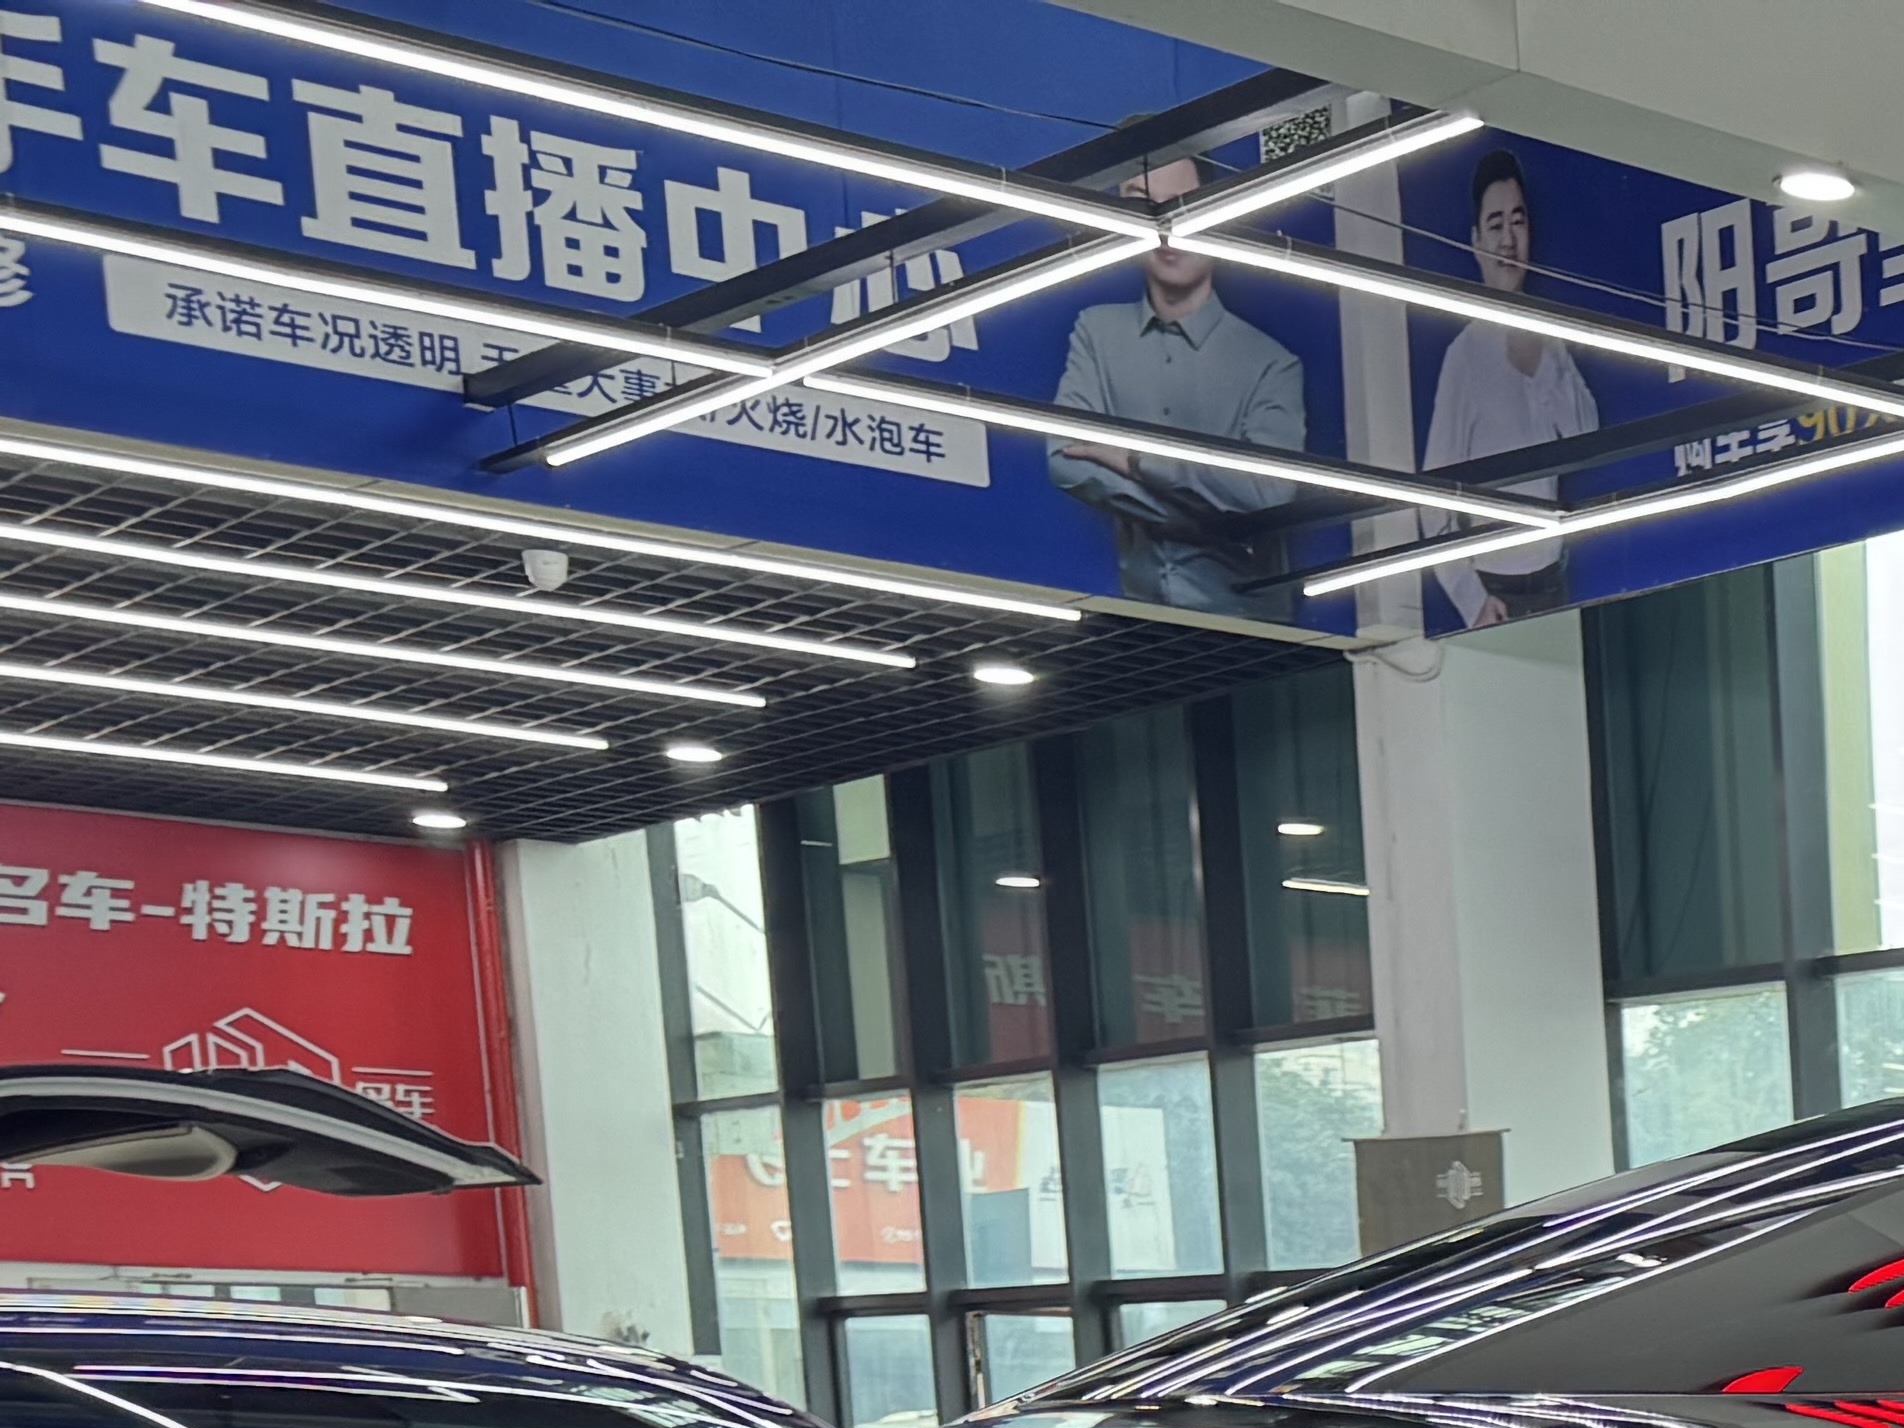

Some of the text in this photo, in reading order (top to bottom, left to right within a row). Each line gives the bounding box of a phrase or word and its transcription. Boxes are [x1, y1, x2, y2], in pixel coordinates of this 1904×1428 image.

[163, 283, 464, 378] 承诺车况透明
